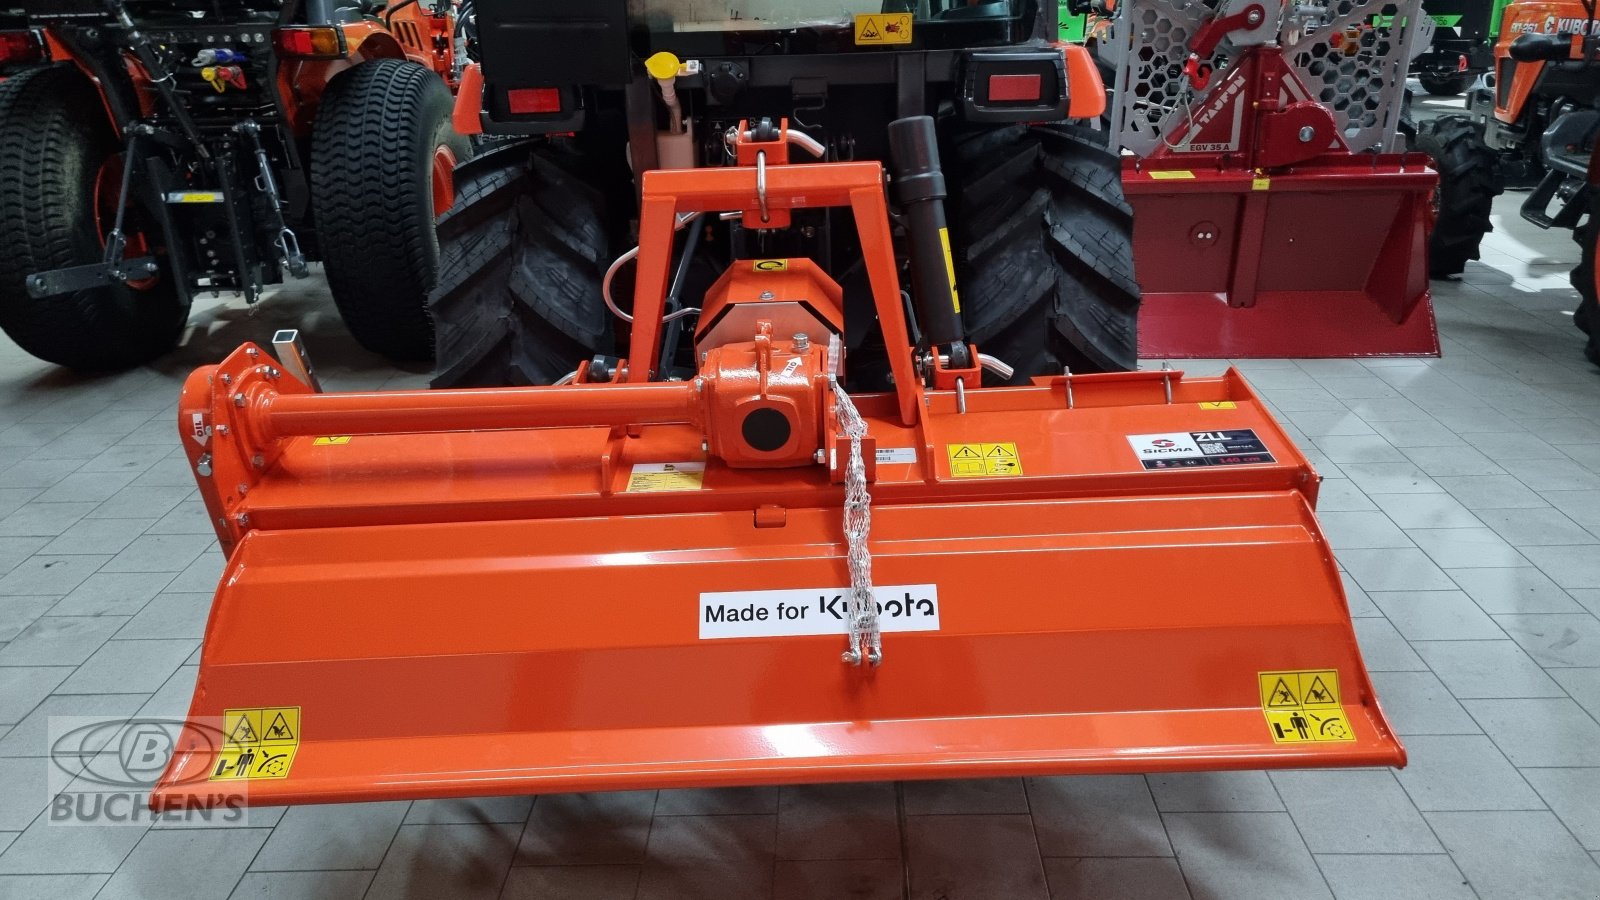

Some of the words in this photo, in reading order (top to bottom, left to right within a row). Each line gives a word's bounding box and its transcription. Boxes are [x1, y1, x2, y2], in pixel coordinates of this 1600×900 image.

[1199, 75, 1246, 124] TAJFUN
[785, 361, 797, 372] OIL
[195, 420, 204, 437] OIL
[1193, 431, 1232, 441] ZLL
[1219, 457, 1241, 465] 140
[705, 604, 769, 623] Made
[776, 602, 809, 620] for
[819, 592, 935, 621] Kota
